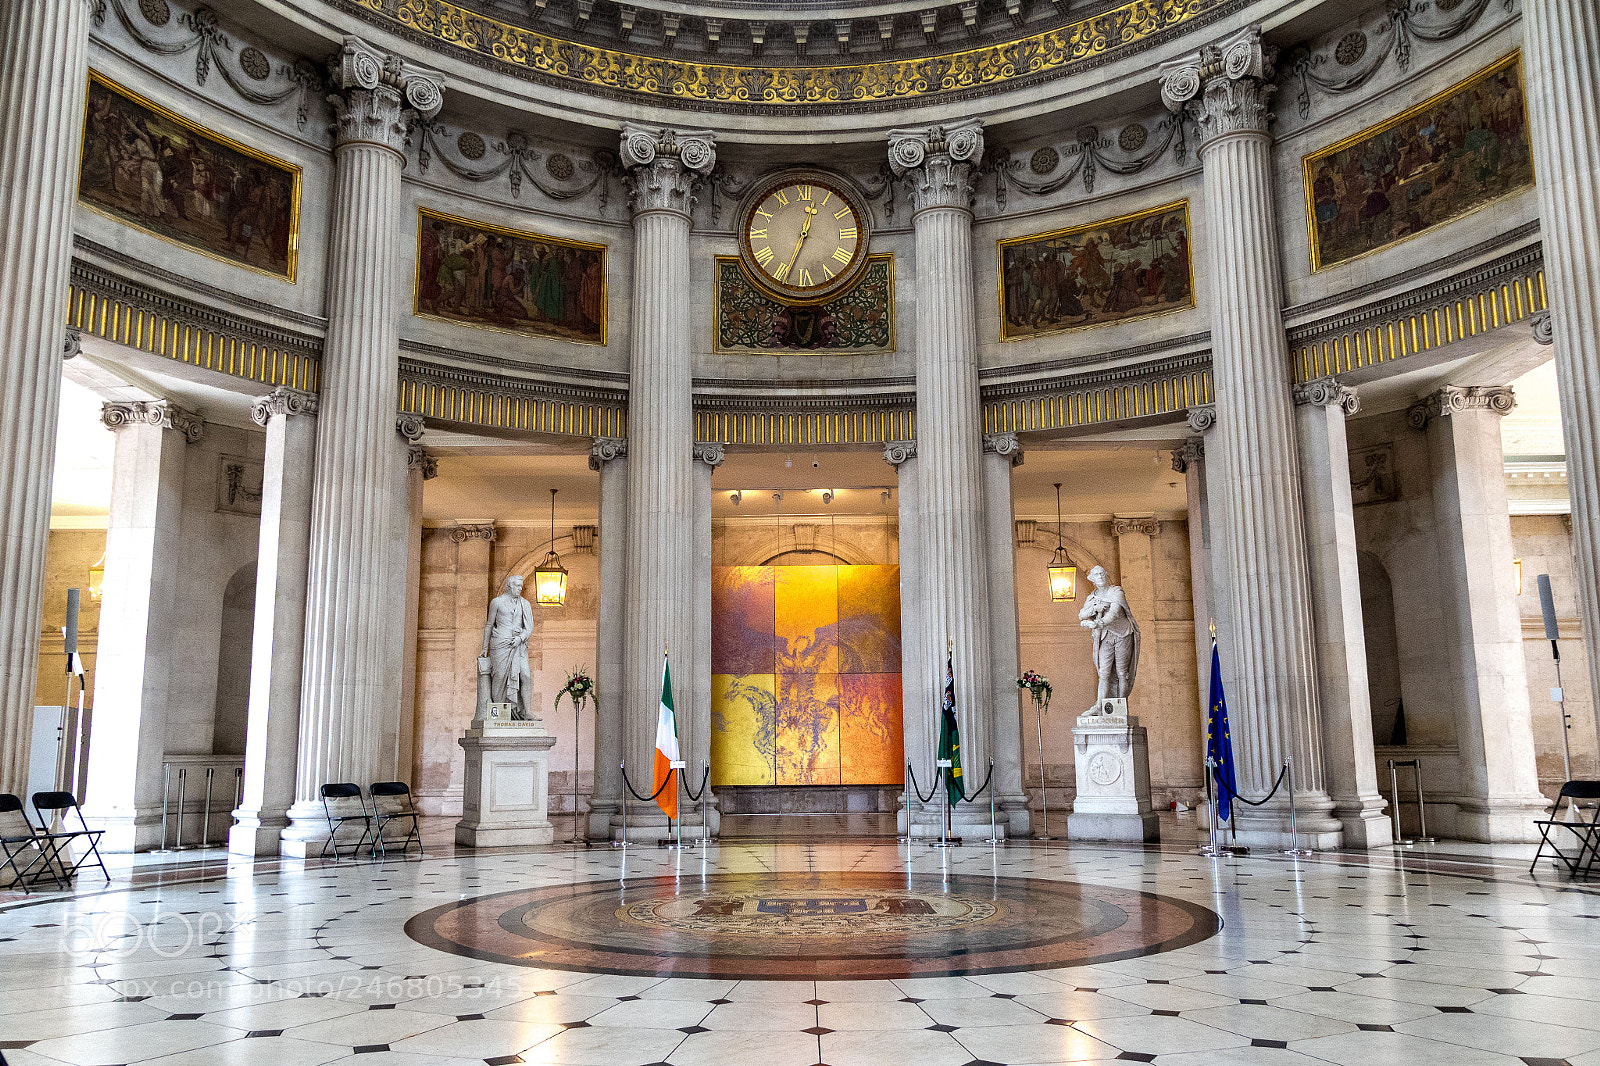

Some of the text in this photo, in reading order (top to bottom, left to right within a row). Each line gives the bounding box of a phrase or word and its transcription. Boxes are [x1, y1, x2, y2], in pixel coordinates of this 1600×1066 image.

[773, 190, 790, 208] XI
[796, 185, 812, 201] XII
[820, 191, 832, 206] I
[755, 205, 774, 223] X
[833, 206, 852, 220] II
[750, 227, 767, 239] IX
[839, 227, 858, 240] III
[754, 246, 775, 269] VIII
[831, 246, 854, 266] IIII
[799, 269, 815, 286] VI
[823, 264, 836, 281] V
